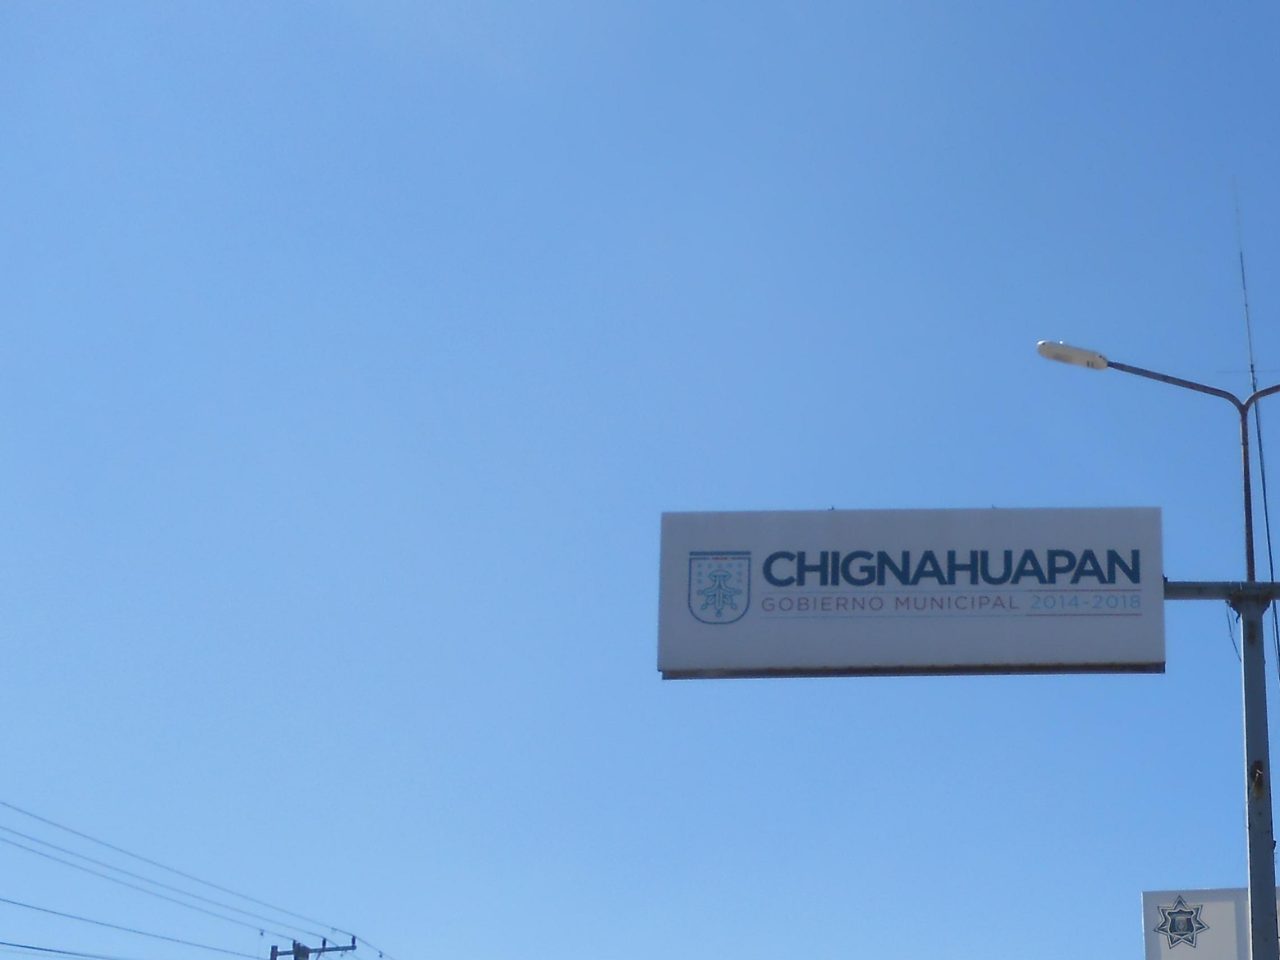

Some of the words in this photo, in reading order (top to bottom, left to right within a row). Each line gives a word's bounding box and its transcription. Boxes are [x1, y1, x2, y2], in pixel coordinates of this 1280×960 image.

[762, 548, 1141, 588] CHIGNAHUAPAN
[761, 596, 884, 612] GOBIERNO
[895, 595, 1021, 611] MUNICIPAL
[1030, 594, 1142, 609] 2014-2018
